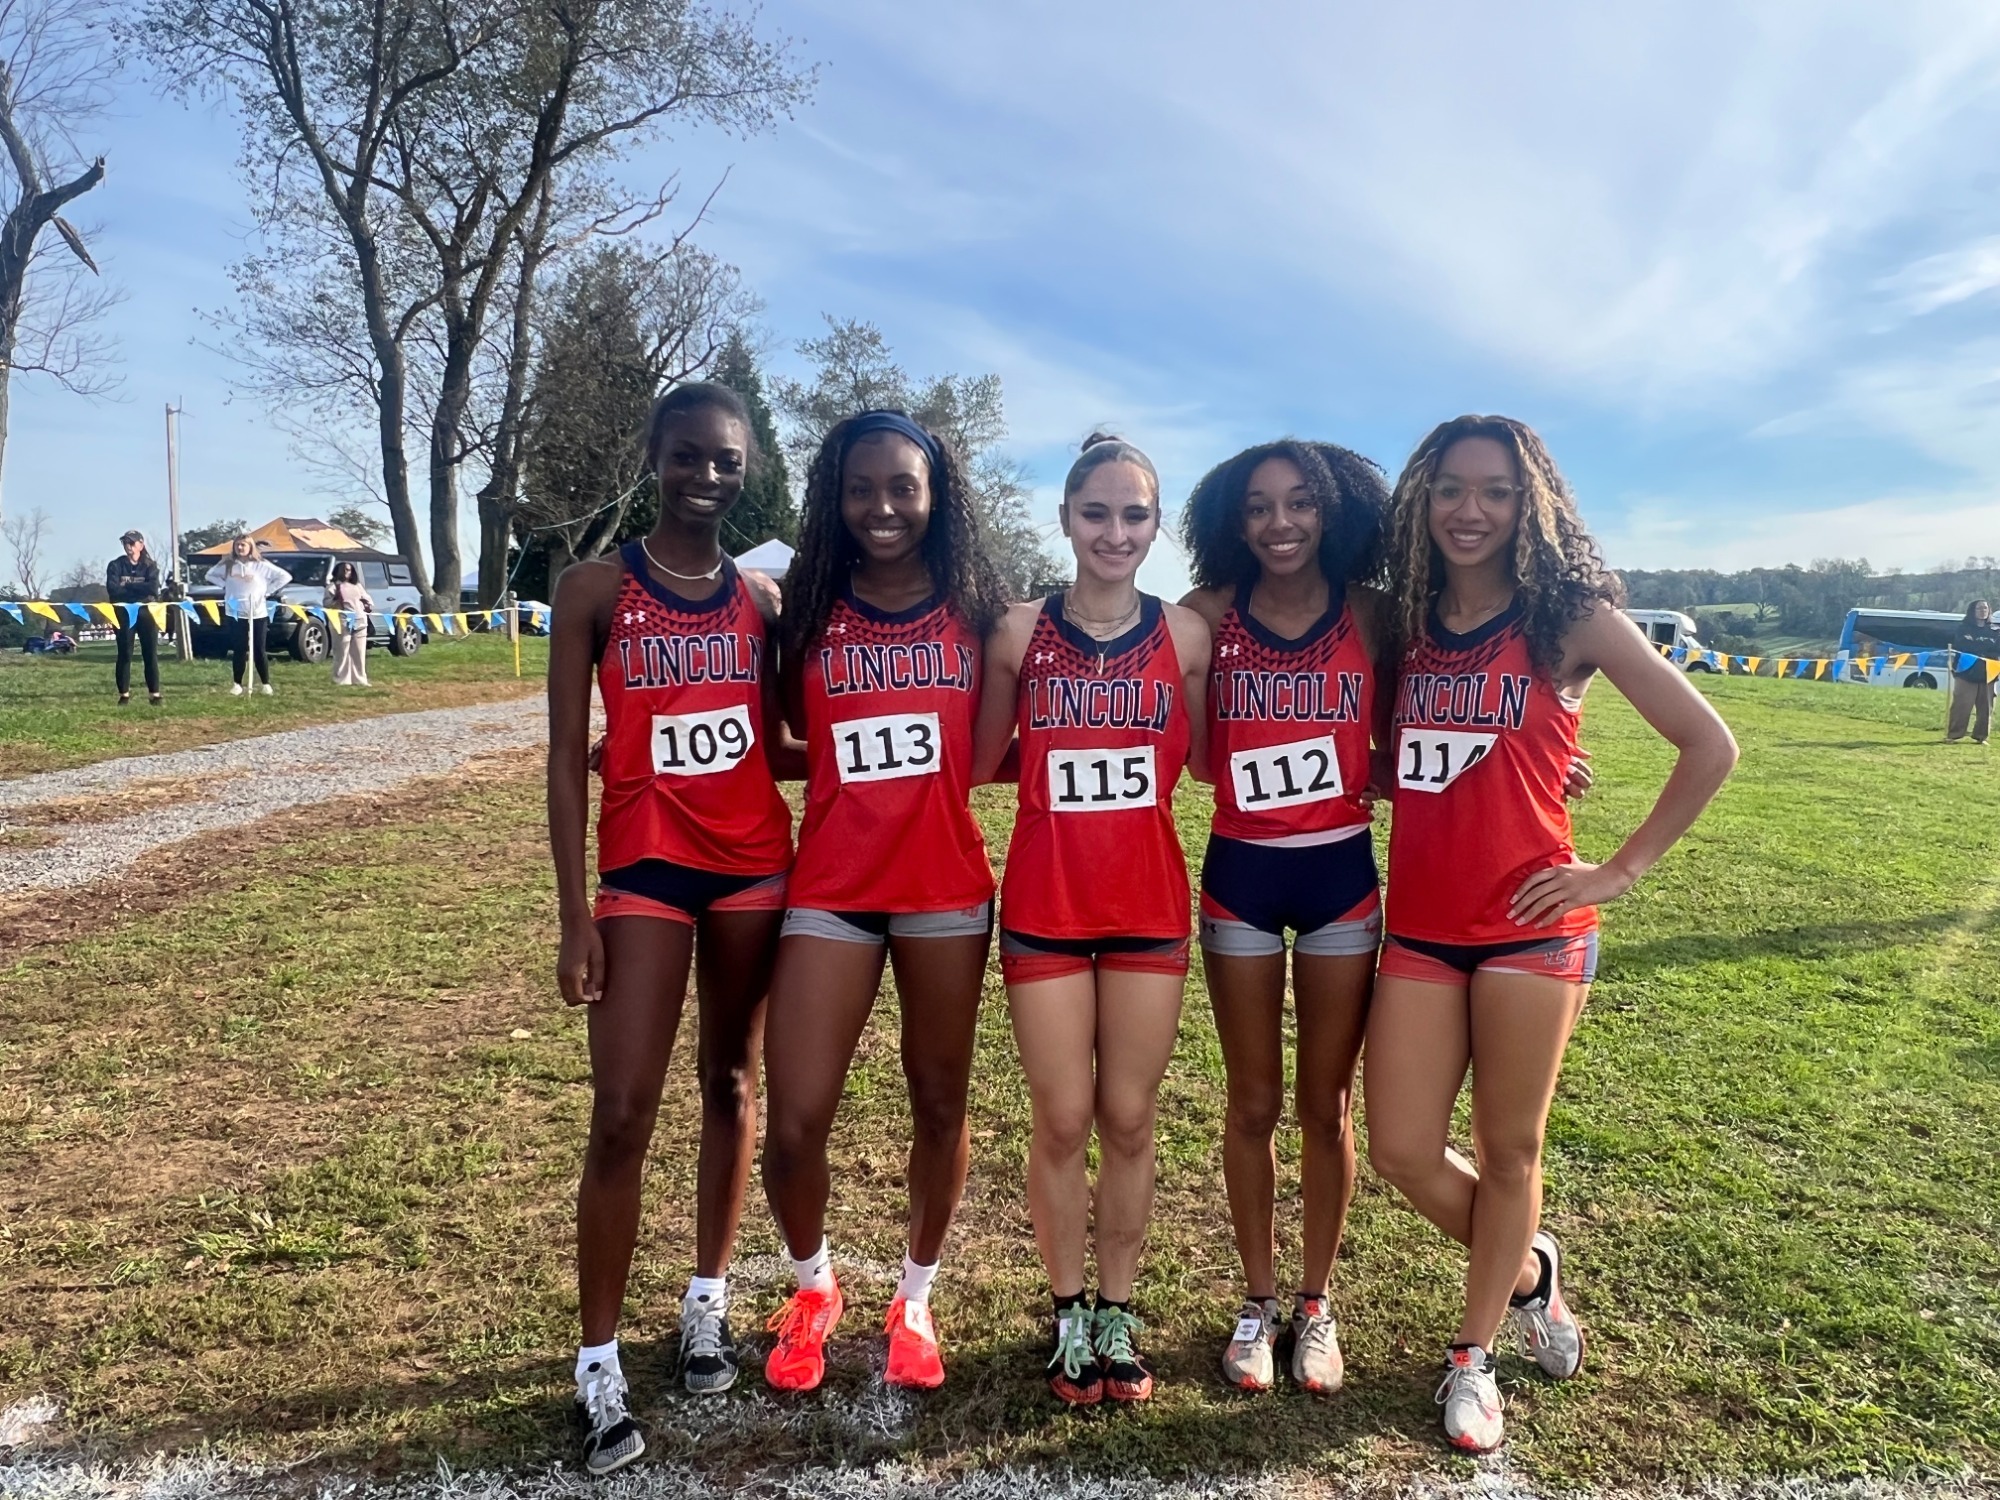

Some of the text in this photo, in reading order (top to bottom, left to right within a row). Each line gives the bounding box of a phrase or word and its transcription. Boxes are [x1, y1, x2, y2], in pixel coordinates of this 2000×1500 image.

[821, 642, 973, 696] LINCOLN
[1029, 677, 1173, 734] LINCOLN
[1215, 671, 1363, 721] LINCOLN
[1396, 673, 1531, 729] INCOLN
[660, 717, 748, 768] 109
[845, 723, 934, 774] 113
[1059, 756, 1149, 802] 115
[1242, 749, 1335, 803] 112
